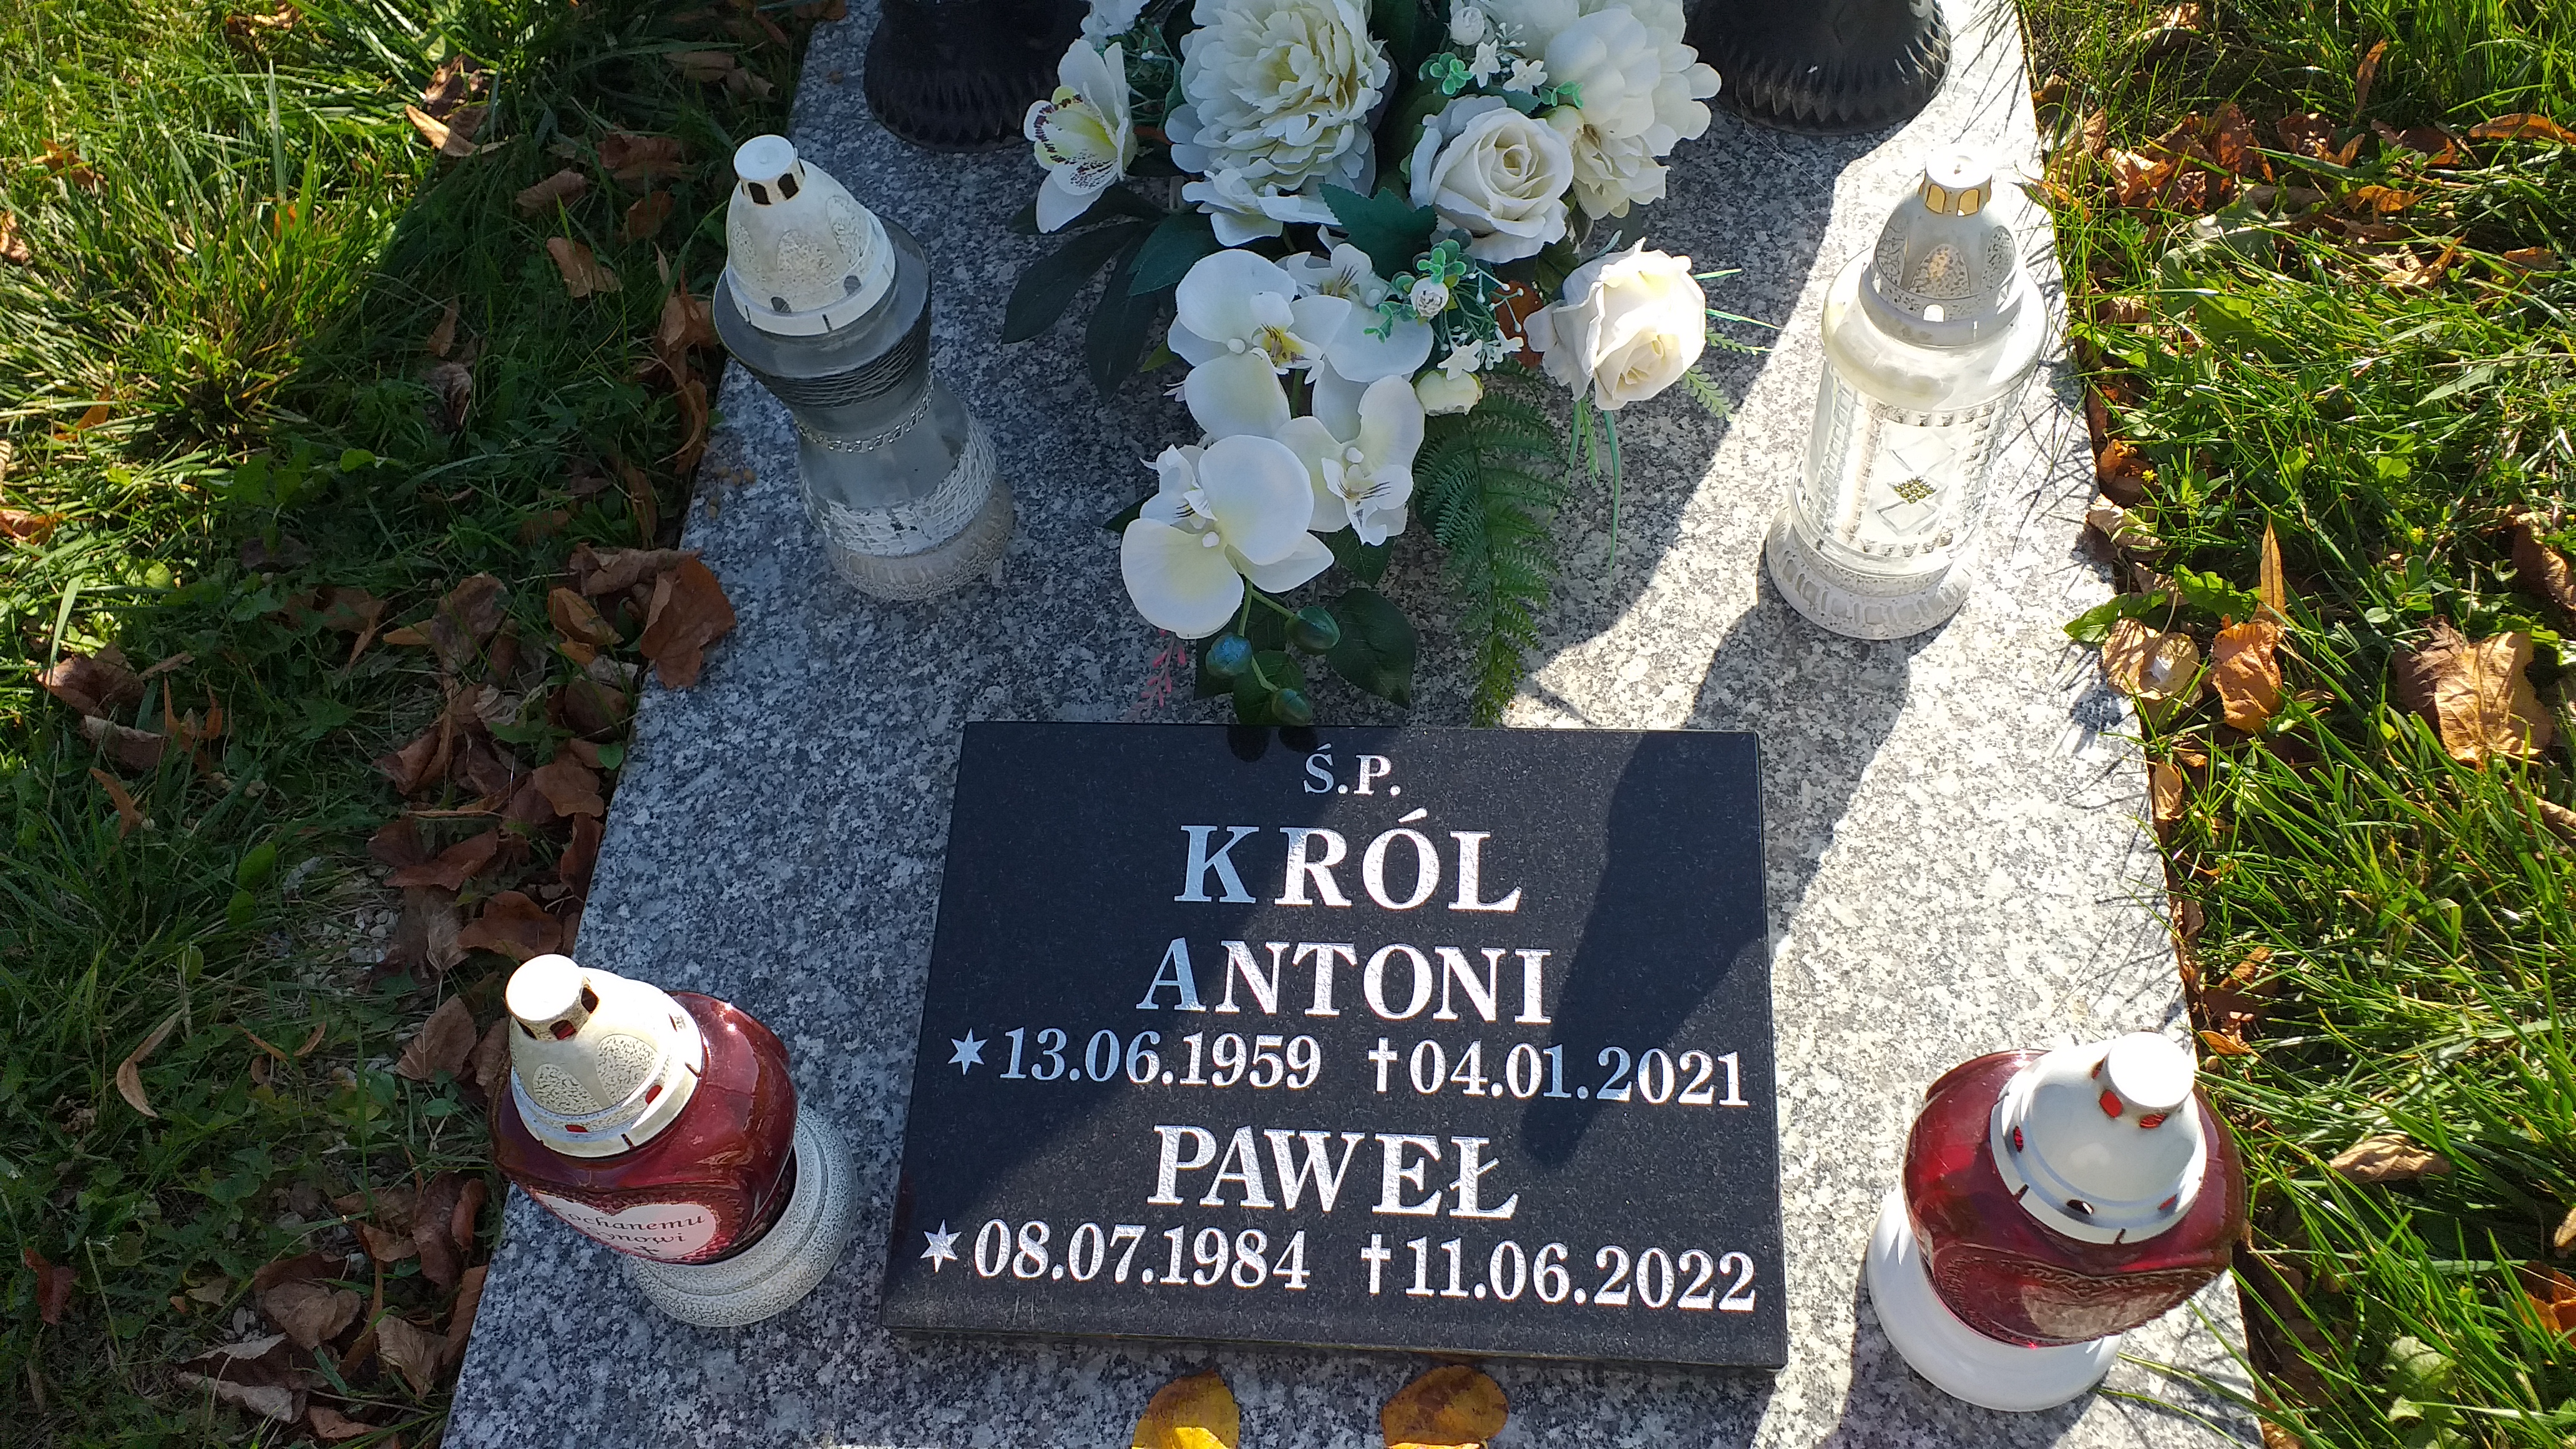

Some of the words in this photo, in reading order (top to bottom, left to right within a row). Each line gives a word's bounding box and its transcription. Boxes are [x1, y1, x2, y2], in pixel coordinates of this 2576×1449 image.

[1303, 743, 1400, 798] Ś.P.
[1175, 808, 1522, 913] KRÓL
[1136, 937, 1551, 1023] ANTONI
[1000, 1027, 1321, 1089] 13.06.1959
[1410, 1040, 1749, 1106] 04.01.2021
[1147, 1125, 1519, 1219] PAWEŁ
[975, 1219, 1311, 1290] 08.07.1984
[1406, 1236, 1754, 1312] 11.06.2022
